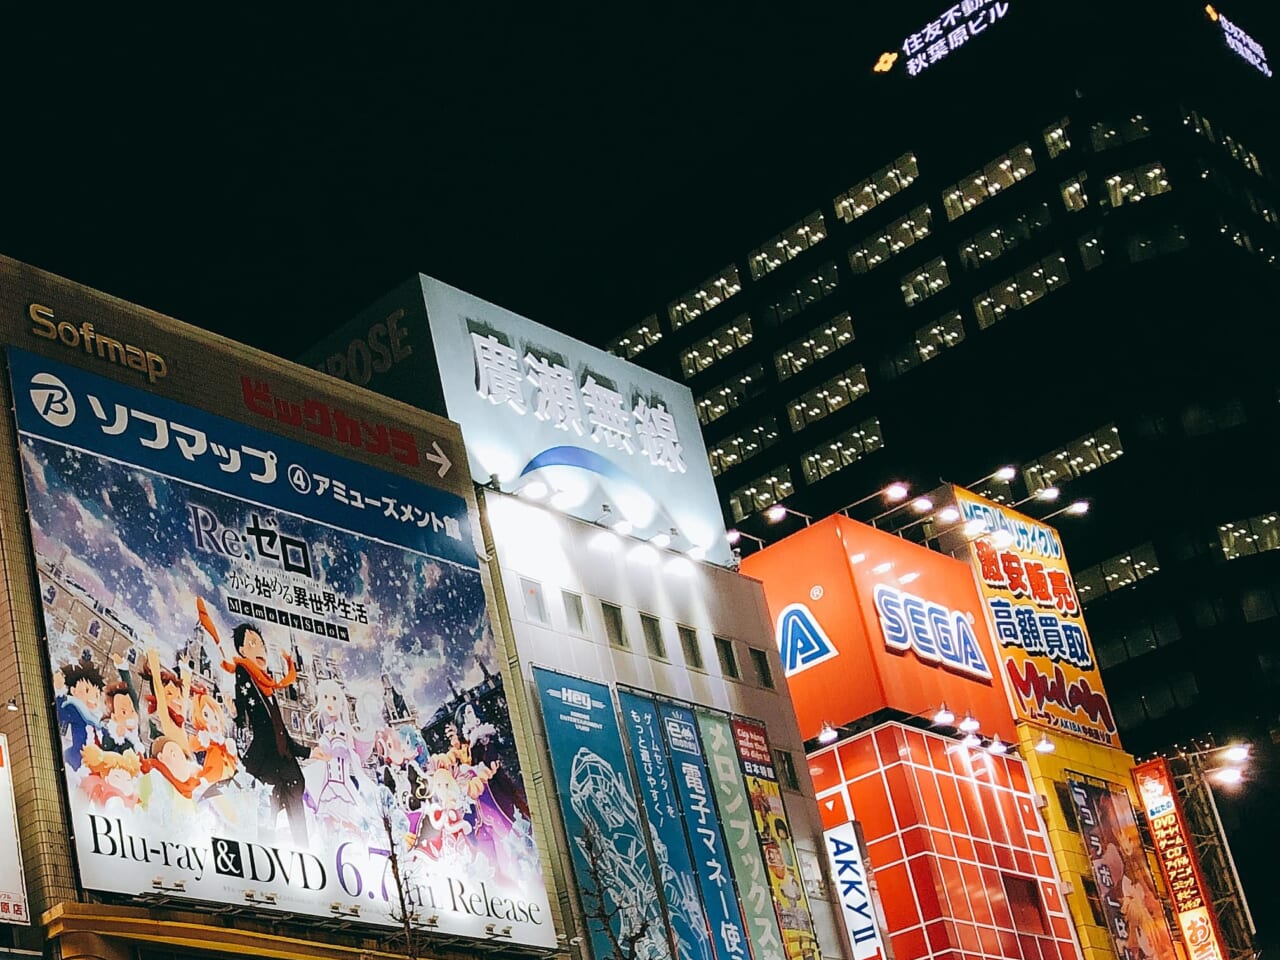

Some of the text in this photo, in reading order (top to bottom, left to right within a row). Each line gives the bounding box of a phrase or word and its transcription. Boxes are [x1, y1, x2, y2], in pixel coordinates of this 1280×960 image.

[902, 0, 992, 56] 住友不動
[906, 2, 1009, 76] 秋葉原ビル
[29, 303, 169, 383] Sofmap
[87, 394, 278, 485] ソフマップ
[241, 375, 419, 467] ビックカメラ
[230, 571, 369, 625] から始める異世界生活
[976, 540, 1078, 616] 激安販売
[874, 584, 993, 684] SEGA
[990, 597, 1092, 668] 高額買取
[562, 688, 591, 708] Hey
[1007, 659, 1116, 733] Mulan
[643, 711, 678, 820] ゲームセンターを
[1153, 814, 1176, 830] DVD
[1158, 836, 1184, 850] ゲーム
[1166, 847, 1183, 859] CD
[85, 812, 209, 881] Blu-ray
[214, 839, 242, 875] &
[246, 842, 327, 892] DVD
[448, 877, 543, 925] Release
[828, 836, 872, 925] AKKY
[1165, 856, 1189, 870] アイドル
[1168, 865, 1193, 881] アニメ
[1172, 877, 1195, 891] コミック
